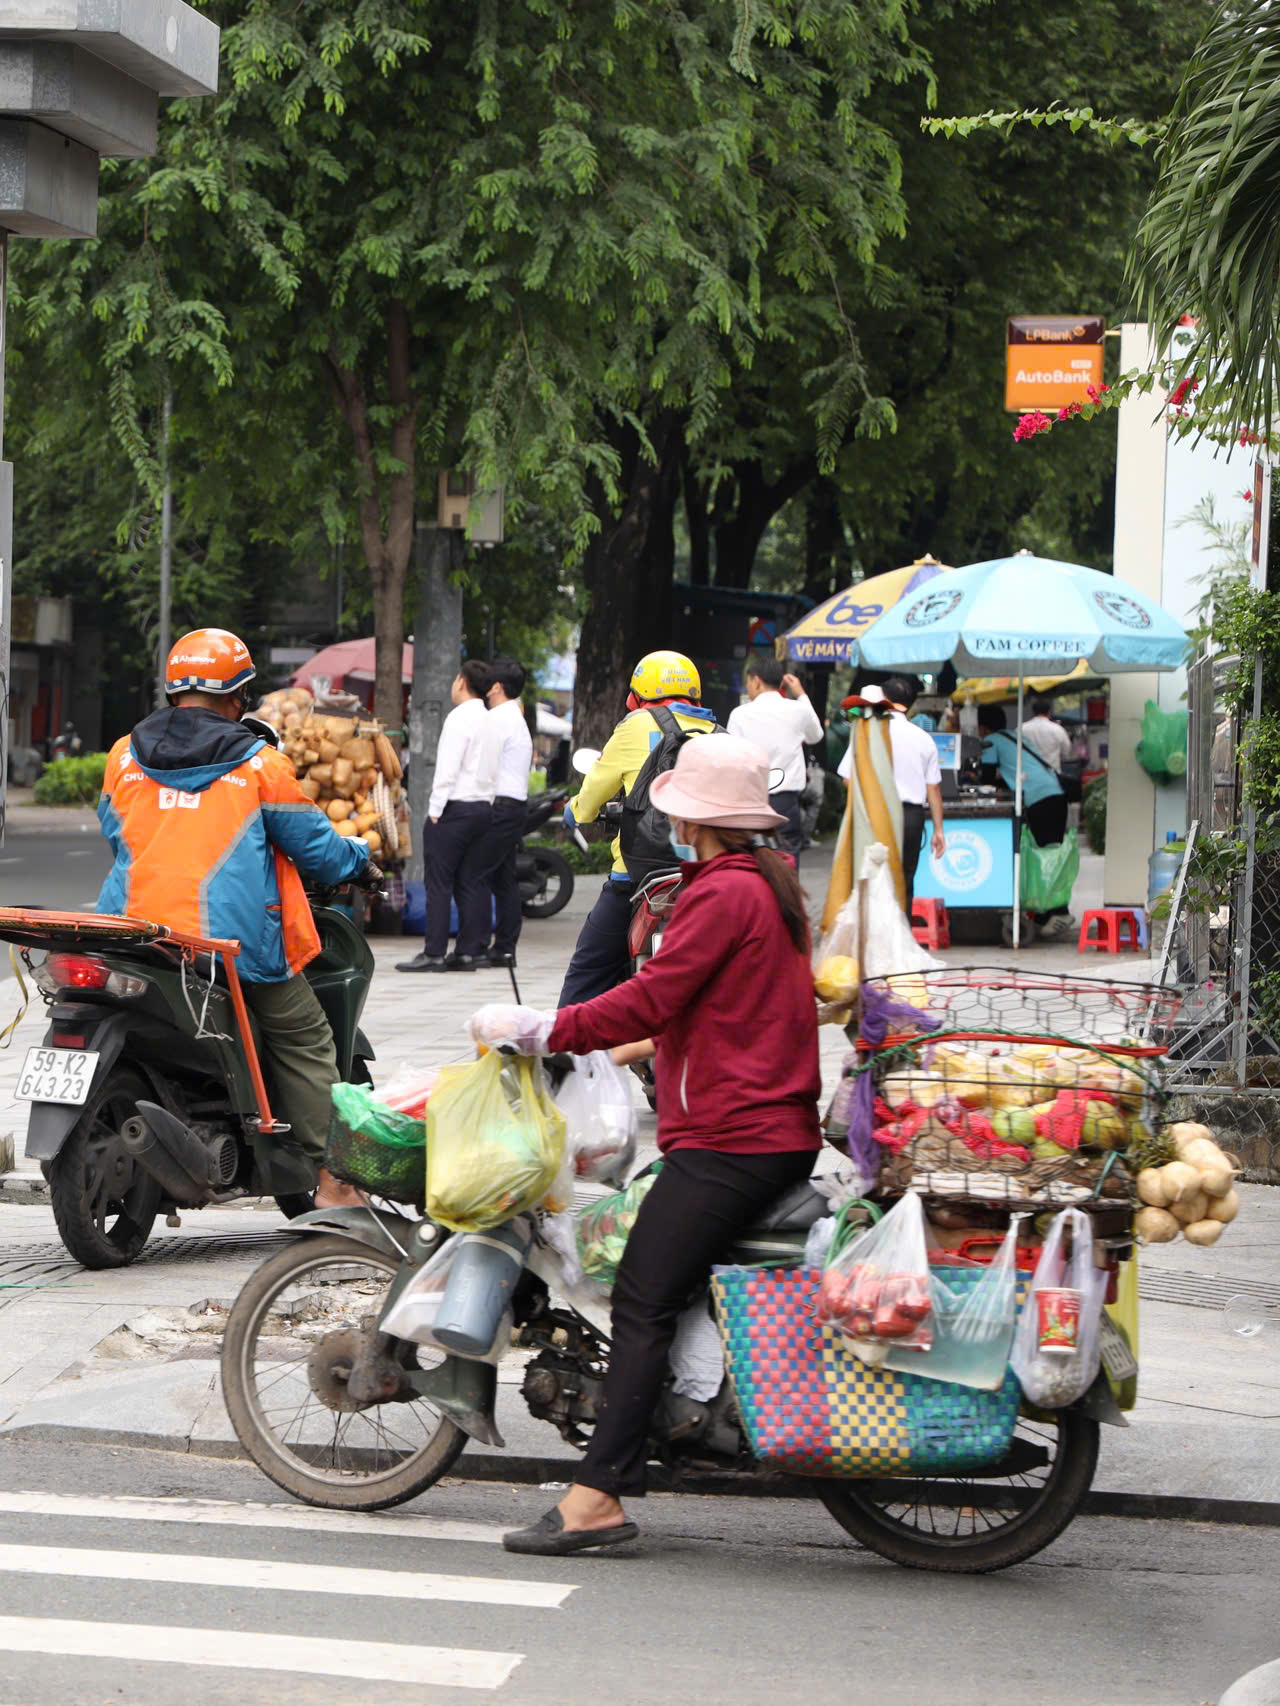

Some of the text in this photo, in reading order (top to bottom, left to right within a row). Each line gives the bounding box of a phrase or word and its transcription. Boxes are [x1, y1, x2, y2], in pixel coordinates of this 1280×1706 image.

[1016, 369, 1091, 384] AutoBank
[825, 595, 884, 626] be
[975, 639, 1086, 653] FAM COFFEE
[33, 1050, 87, 1076] 59-K2
[21, 1074, 84, 1100] 643.23
